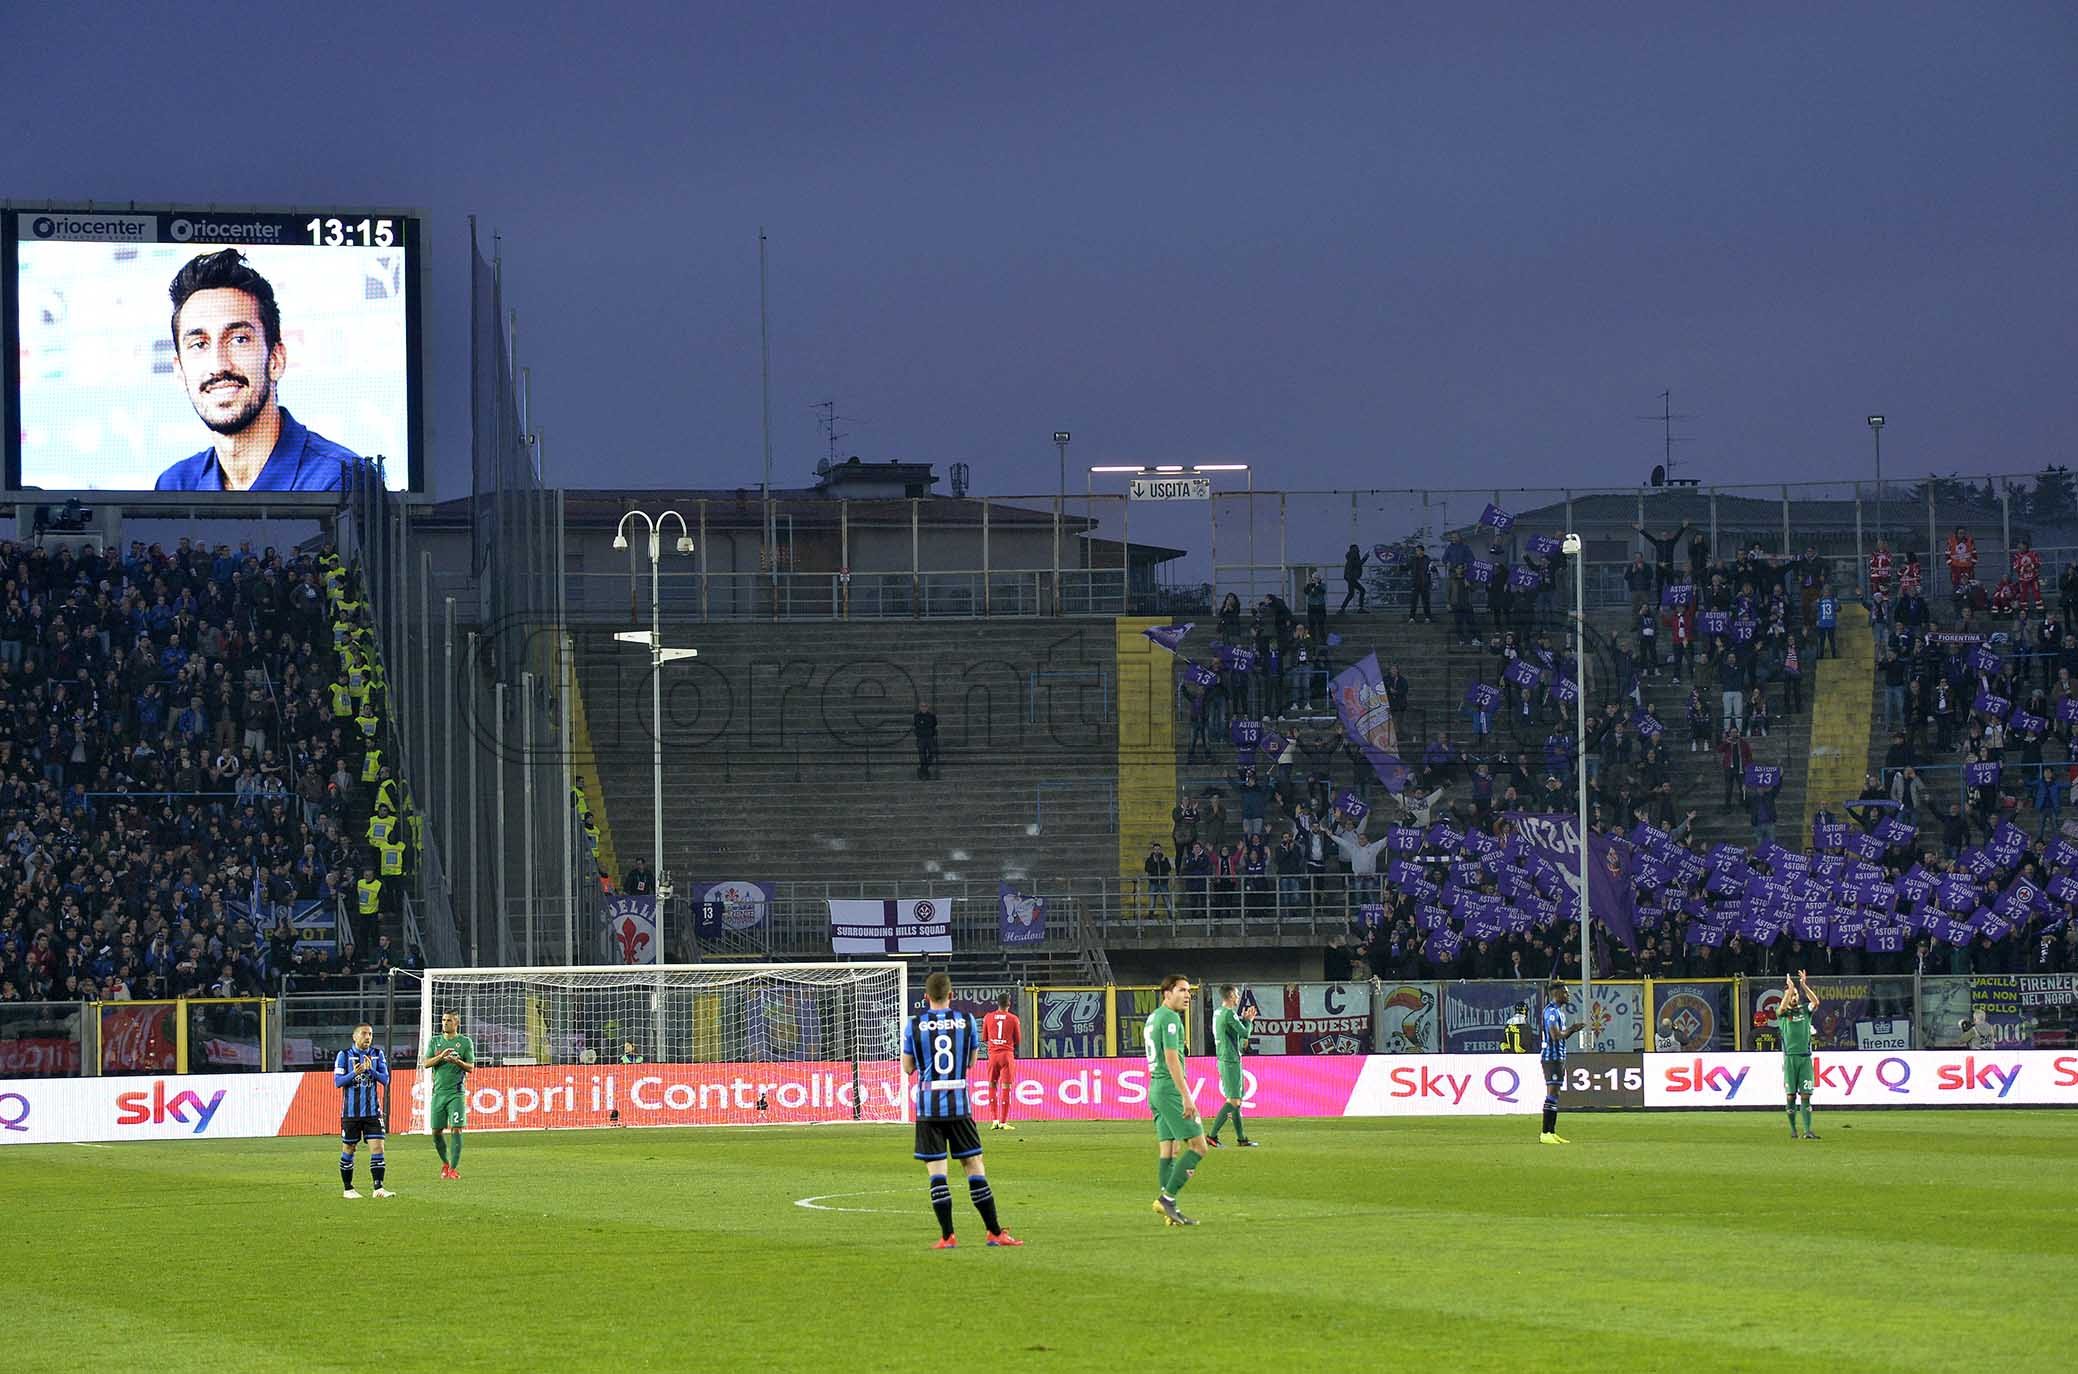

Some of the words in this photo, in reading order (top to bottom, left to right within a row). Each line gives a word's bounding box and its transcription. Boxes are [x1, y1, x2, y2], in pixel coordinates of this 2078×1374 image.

[306, 219, 392, 248] 13:15
[1150, 483, 1191, 498] USCITA
[1475, 569, 1488, 582] 13
[1822, 603, 1832, 615] 13
[1709, 620, 1723, 632] 13
[1738, 628, 1752, 639] 13
[1233, 658, 1247, 671] 13
[1978, 658, 1993, 670] 13
[1517, 671, 1532, 684] 13
[1985, 702, 2001, 713] 13
[1242, 729, 1256, 742] 13
[1974, 762, 1996, 771] ASTORI
[1757, 773, 1773, 784] 13
[1977, 772, 1992, 784] 13
[1346, 802, 1362, 815] 13
[1822, 824, 1846, 832] ASTORI
[1889, 820, 1913, 832] ASTORI
[1400, 836, 1414, 849] 13
[1826, 833, 1842, 845] 13
[2006, 831, 2022, 846] 13
[1860, 843, 1876, 858] 13
[1970, 860, 1986, 874] 13
[1842, 890, 1857, 902] 13
[1906, 888, 1922, 900] 13
[2060, 887, 2077, 900] 13
[1667, 898, 1681, 911] 13
[703, 906, 714, 919] 13
[1426, 915, 1441, 928] 13
[1803, 916, 1826, 924] ASTORI
[1922, 915, 1938, 928] 13
[837, 925, 893, 938] SURROUNDING
[896, 926, 917, 937] HILLS
[919, 924, 946, 936] SQUAD
[1753, 927, 1770, 941] 13
[1806, 925, 1821, 939] 13
[1874, 927, 1899, 936] ASTORI
[1981, 922, 1998, 935] 13
[1701, 932, 1716, 944] 13
[1948, 929, 1964, 942] 13
[1879, 937, 1895, 950] 13
[1325, 986, 1346, 1014] C
[1972, 991, 1988, 1000] MA
[1993, 991, 2017, 1001] NON
[2022, 993, 2041, 1006] NEL
[2044, 993, 2072, 1006] NORD
[1484, 1009, 1495, 1025] DI
[919, 1018, 966, 1031] GOSENS
[996, 1020, 1003, 1040] 1
[1863, 1038, 1905, 1049] firenze
[934, 1034, 954, 1074] 8
[1665, 1057, 1751, 1100] sky
[1814, 1057, 1863, 1096] ky
[1876, 1057, 1911, 1094] Q
[1938, 1056, 2023, 1098] sky
[592, 1076, 614, 1111] il
[630, 1073, 868, 1110] Controllo
[1058, 1069, 1103, 1104] di
[1390, 1066, 1472, 1105] Sky
[1484, 1066, 1520, 1104] Q
[116, 1080, 228, 1133] sky
